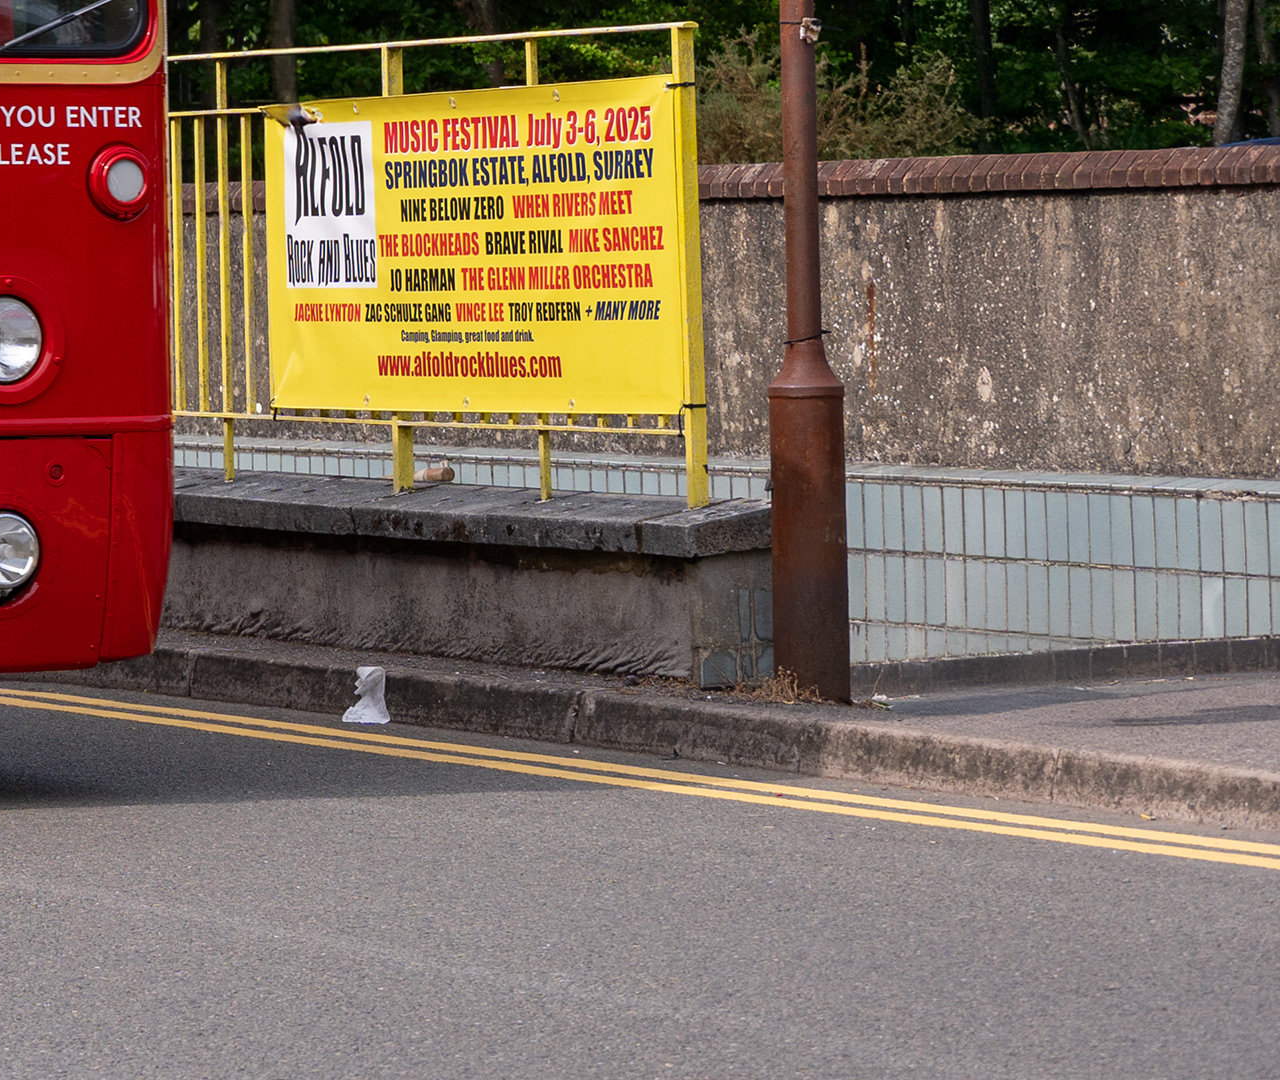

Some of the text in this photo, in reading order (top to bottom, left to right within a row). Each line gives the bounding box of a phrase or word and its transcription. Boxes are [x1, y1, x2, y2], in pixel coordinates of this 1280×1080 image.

[0, 105, 55, 127] YOU
[66, 106, 142, 128] ENTER
[384, 106, 651, 154] MUSIC FESTIVAL July 3-6, 2025
[291, 121, 365, 226] ALFOLD
[384, 148, 654, 190] SPRINGBOK ESTATE, ALFOLD, SURREY
[401, 190, 633, 222] NINE BELOW ZERO WHEN RIVERS MEET
[379, 225, 664, 257] THE BLOCKHEADS BRAVE RIVAL MIKE SANCHEZ
[390, 263, 653, 292] JO HARMAN THE GLENN MILLER ORCHESTRA
[294, 300, 661, 322] JACKIE LYNTON ZAC SCHULZE GANG VINCE LEE TROY REDFERN + MANY MORE
[401, 329, 430, 343] Camping,
[465, 330, 483, 343] great
[485, 330, 499, 342] food
[501, 330, 513, 342] and
[515, 329, 534, 342] drink.
[377, 351, 563, 378] www.alfoldrockblues.com
